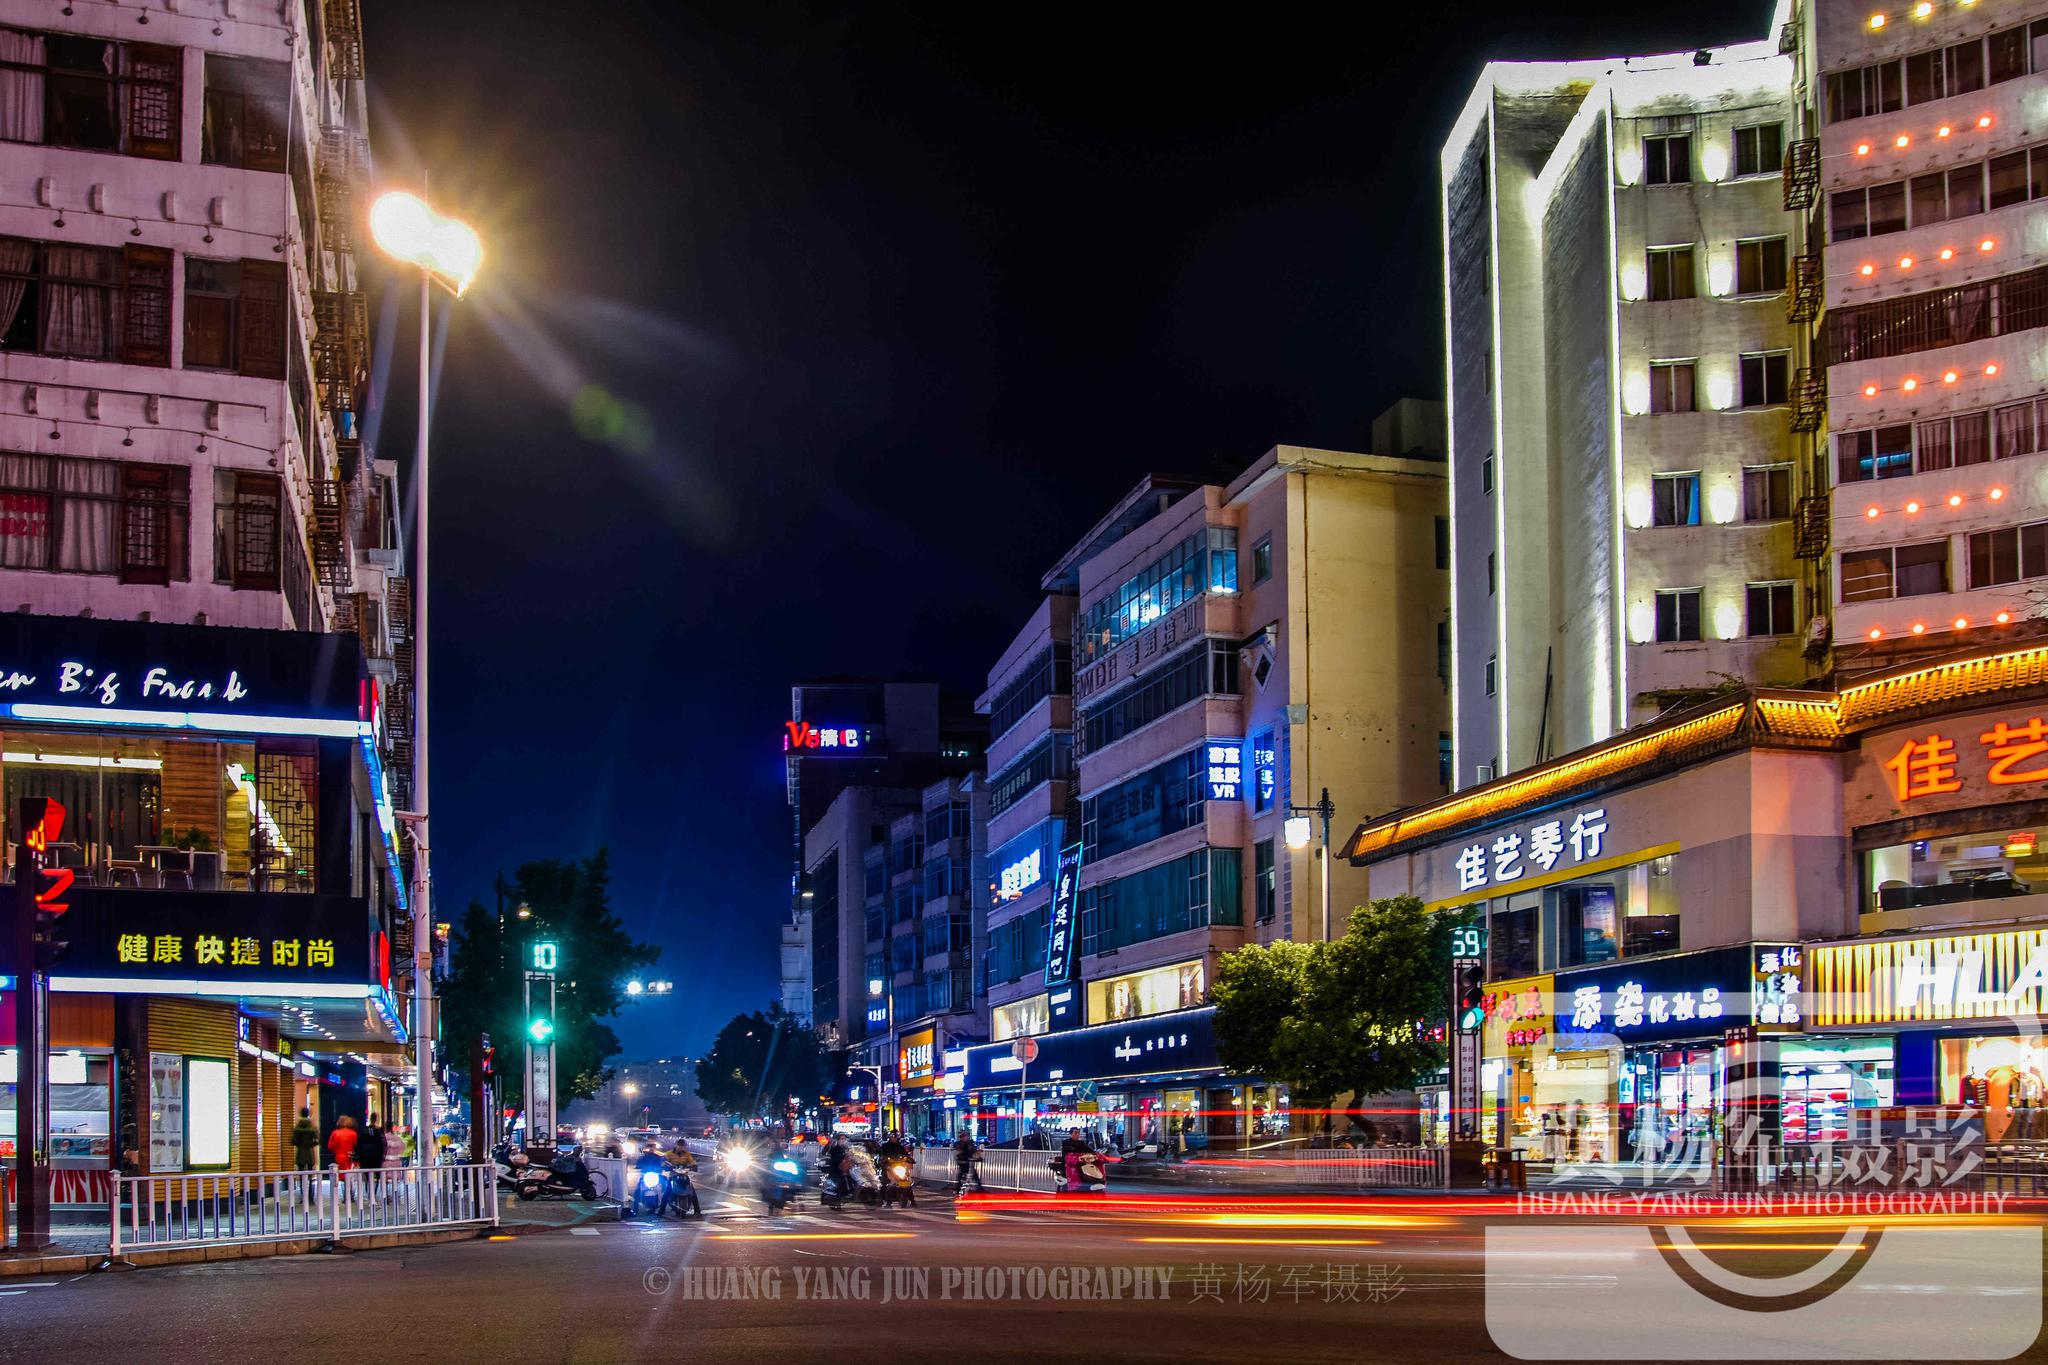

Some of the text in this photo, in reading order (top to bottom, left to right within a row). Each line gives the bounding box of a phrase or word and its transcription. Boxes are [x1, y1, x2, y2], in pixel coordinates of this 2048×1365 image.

[59, 661, 121, 705] Big
[1885, 717, 2048, 802] 佳艺
[1213, 784, 1235, 798] VR
[1455, 808, 1609, 891] 佳艺琴行
[118, 933, 335, 968] 健康 快捷 时尚
[534, 943, 557, 970] 10
[1900, 947, 2048, 1008] HLA
